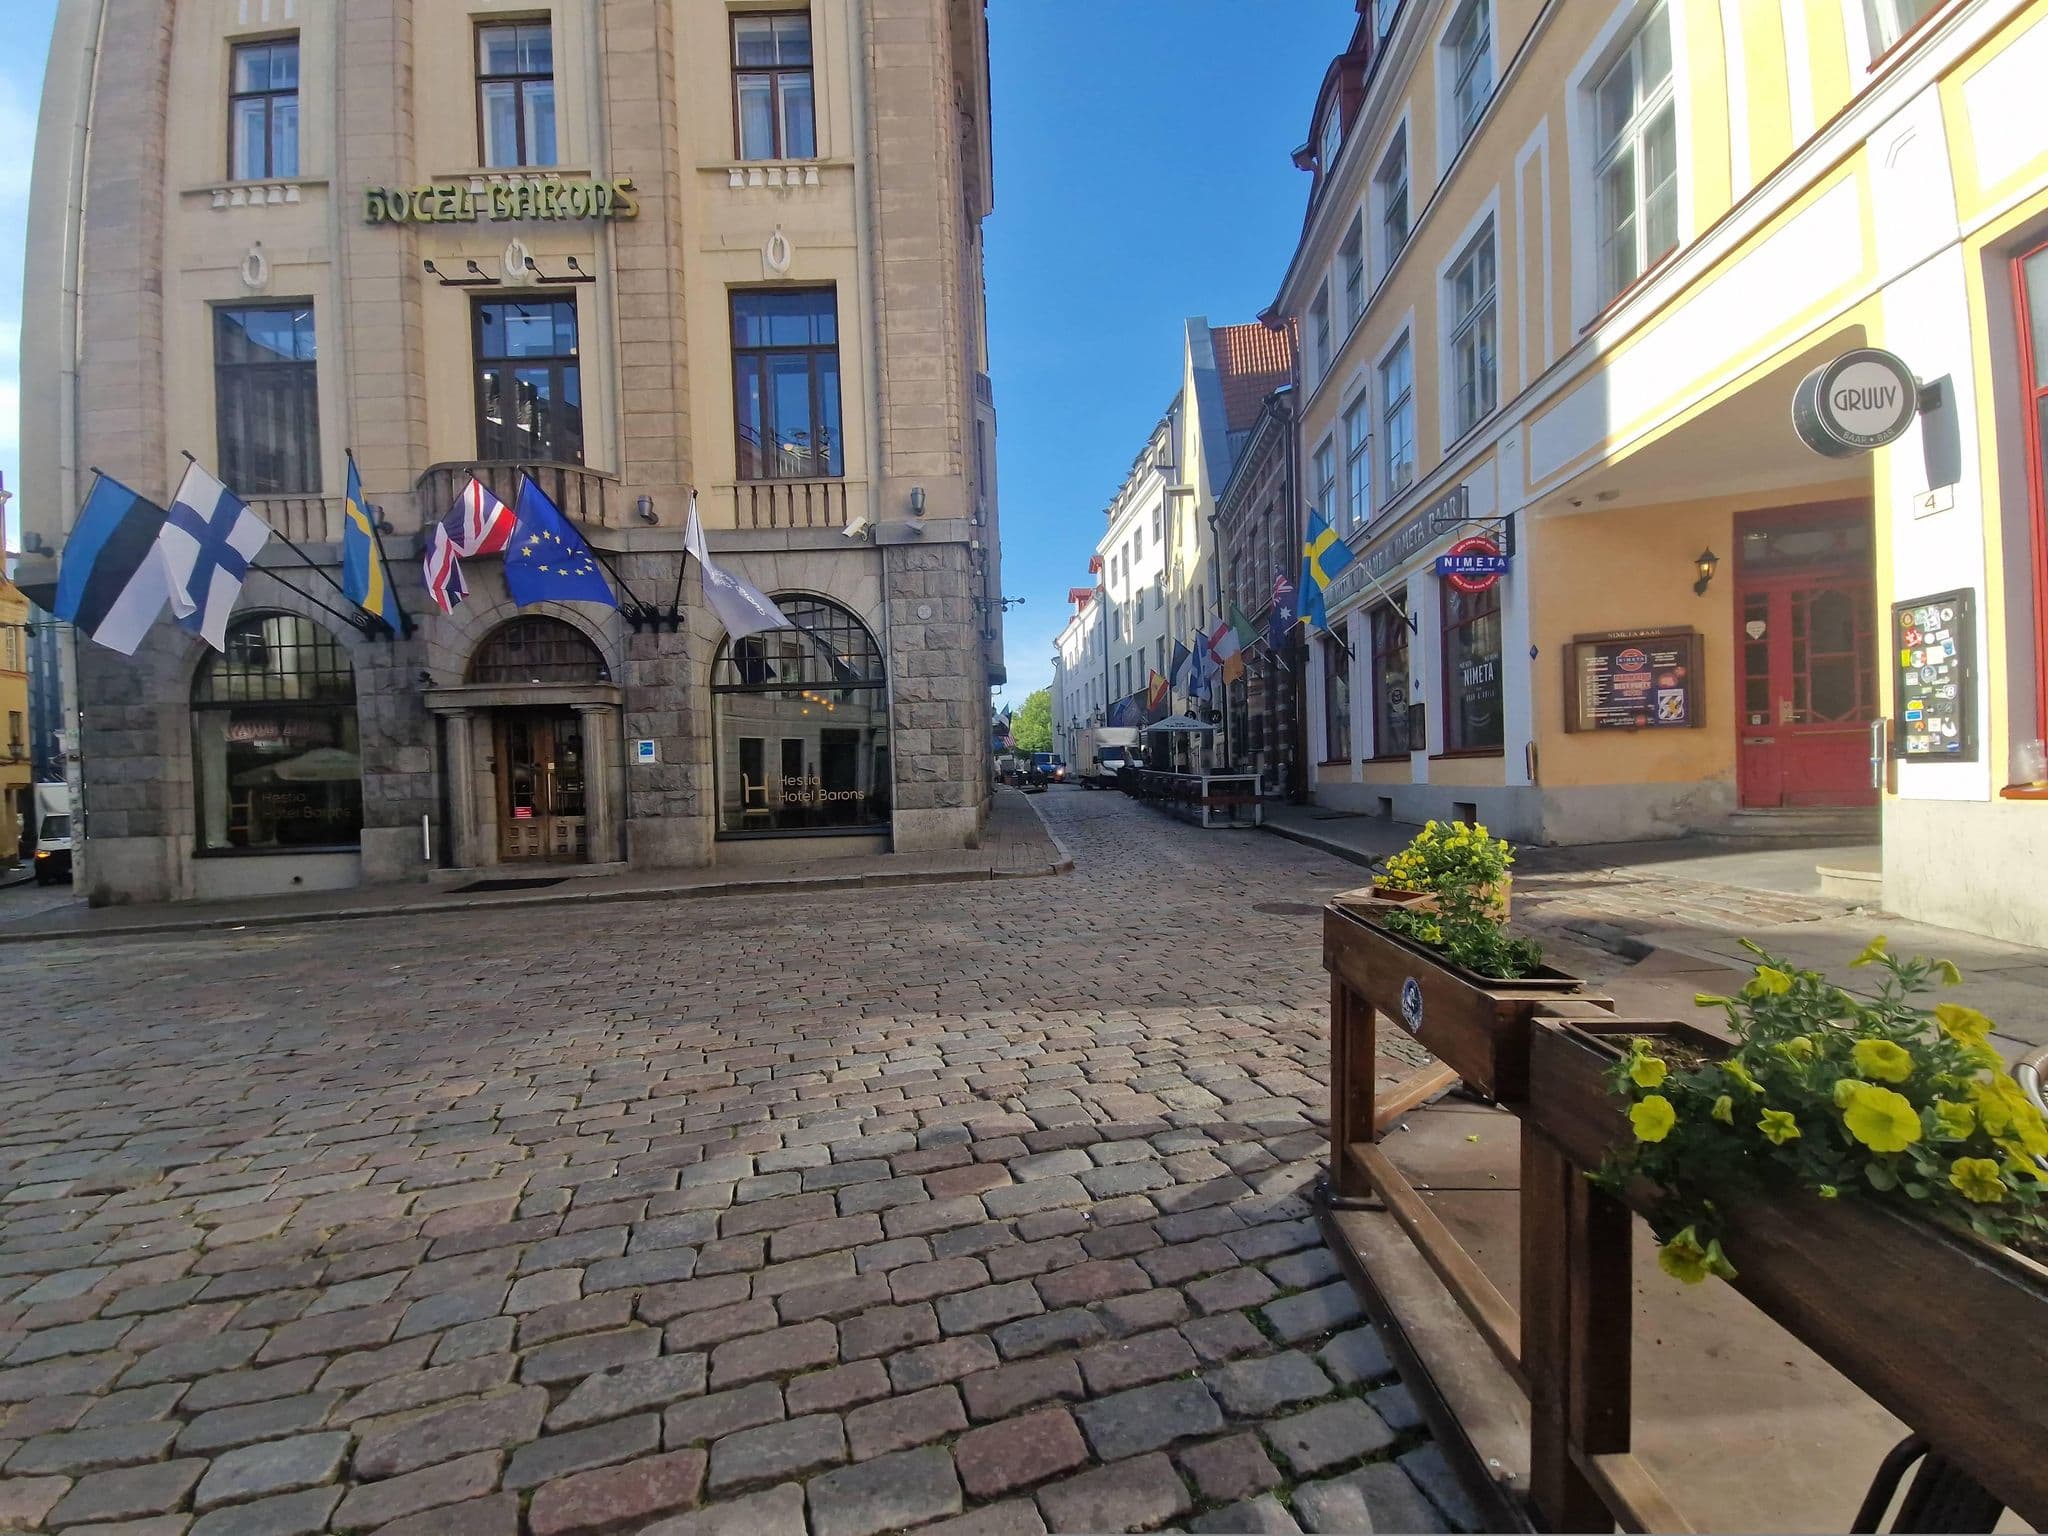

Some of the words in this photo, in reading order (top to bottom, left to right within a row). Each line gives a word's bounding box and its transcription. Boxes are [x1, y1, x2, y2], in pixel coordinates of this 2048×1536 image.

[364, 184, 478, 223] HOTEL
[486, 178, 640, 221] BARONS
[1834, 385, 1896, 411] GRUUV
[1843, 431, 1867, 444] BAAR
[1877, 429, 1896, 442] BAR
[1924, 494, 1937, 509] 4
[1444, 556, 1506, 567] NIMETA
[1464, 662, 1494, 687] NIMETA
[779, 774, 821, 786] Hestia
[779, 791, 814, 802] Hotel
[818, 789, 865, 801] Barons
